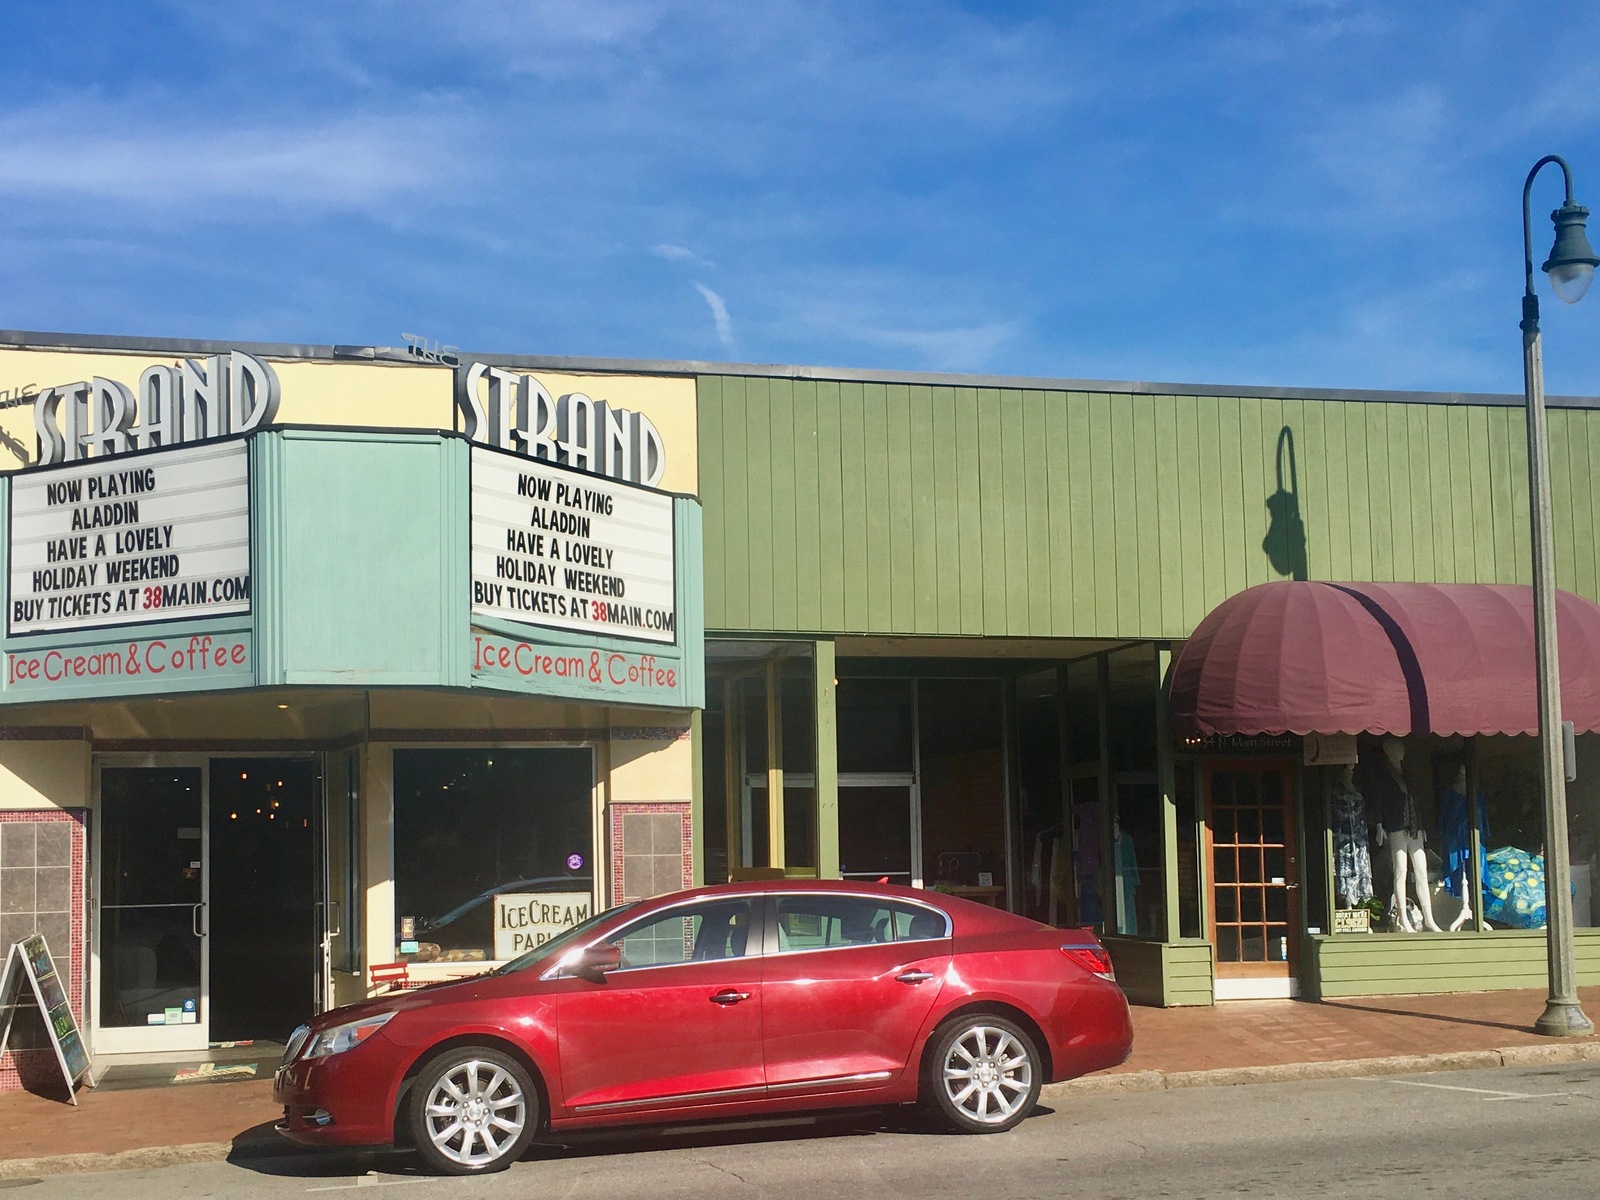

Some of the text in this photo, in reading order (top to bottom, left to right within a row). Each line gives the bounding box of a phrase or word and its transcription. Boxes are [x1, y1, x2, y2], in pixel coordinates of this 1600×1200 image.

[34, 349, 281, 466] STRAND
[459, 361, 666, 488] STRAND
[47, 468, 156, 506] NOW PLAYING
[517, 473, 613, 516] NOW PLAYING
[71, 500, 139, 531] ALADDIN
[531, 506, 591, 539] ALADDIN
[47, 525, 173, 563] HAVE A LOVELY
[507, 529, 614, 570] HAVE A LOVELY
[32, 554, 180, 593] HOLIDAY WEEKEND
[496, 555, 625, 598] HOLIDAY WEEKEND
[13, 575, 250, 623] BUY TICKETS AT 38MAIN.COM
[474, 580, 675, 632] BUY TICKETS AT 38MAIN.COM
[145, 635, 247, 674] Coffee
[607, 654, 677, 688] Coffee
[1231, 737, 1257, 747] Main
[1259, 736, 1293, 747] Street
